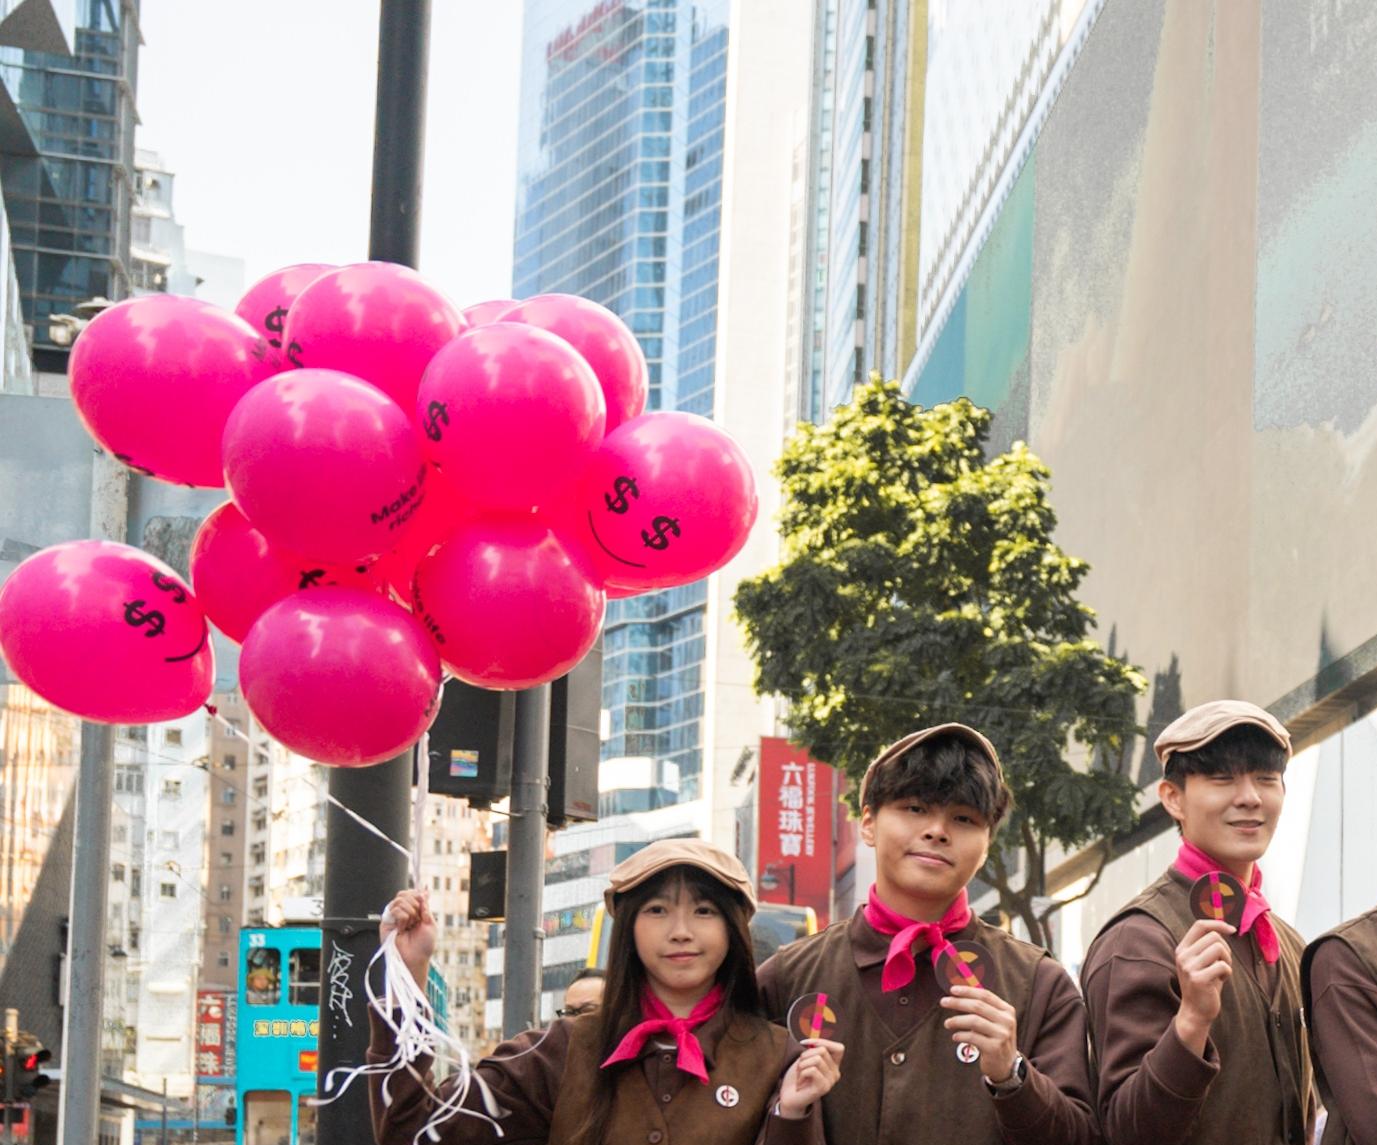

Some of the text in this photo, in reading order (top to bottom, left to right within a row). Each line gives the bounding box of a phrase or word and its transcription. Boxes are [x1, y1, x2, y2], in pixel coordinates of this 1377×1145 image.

[604, 476, 682, 551] $ $
[123, 599, 166, 639] $
[249, 933, 267, 948] 33
